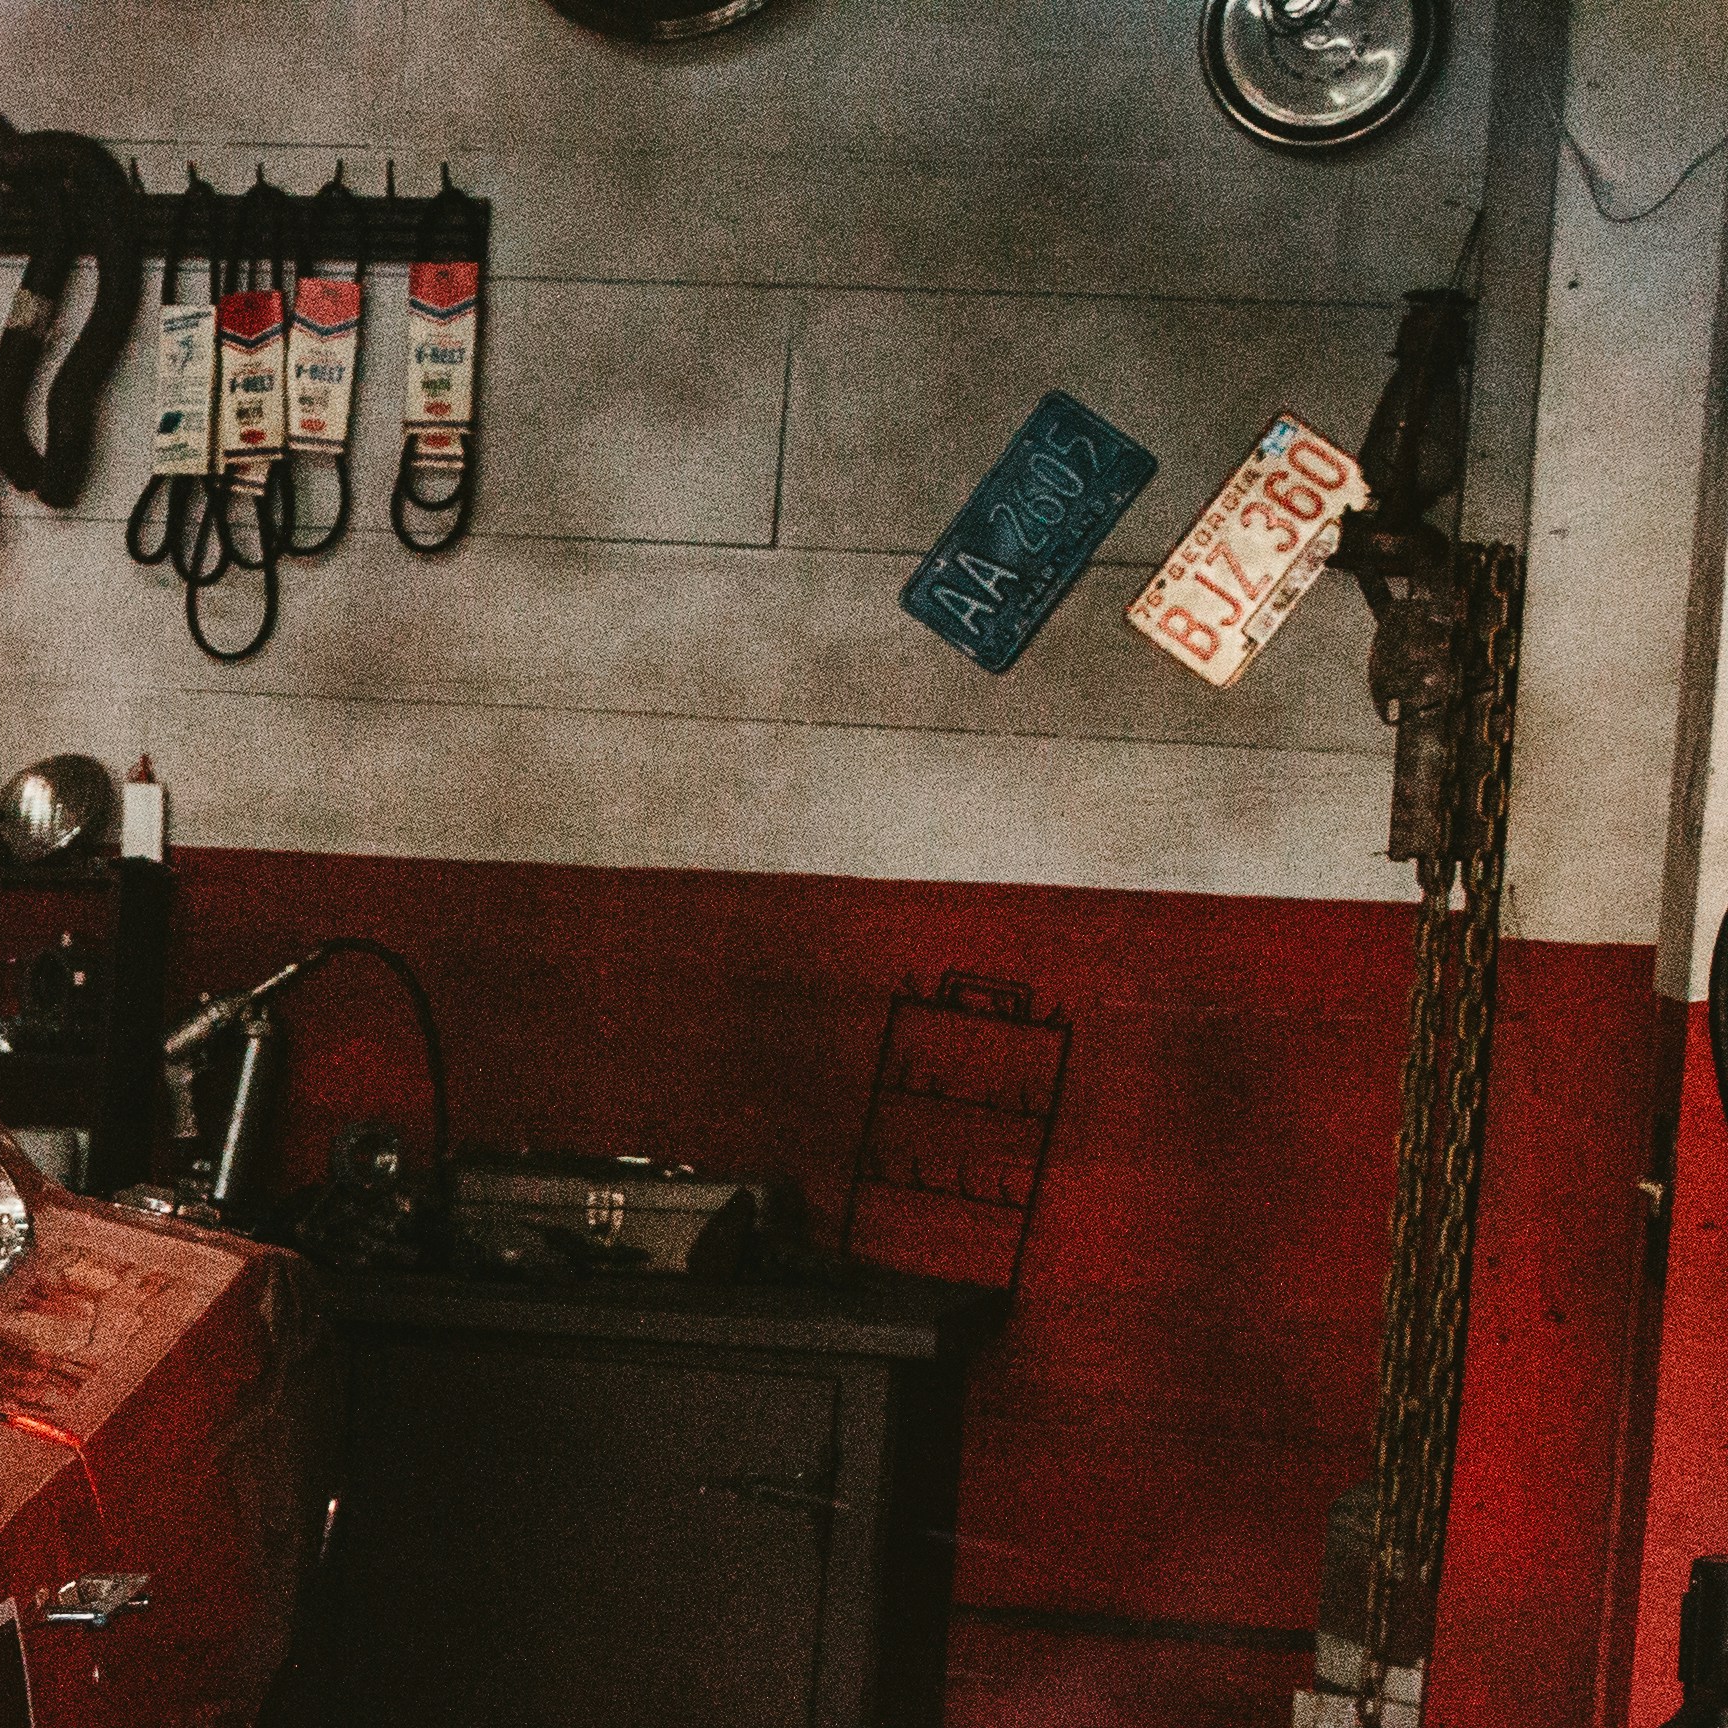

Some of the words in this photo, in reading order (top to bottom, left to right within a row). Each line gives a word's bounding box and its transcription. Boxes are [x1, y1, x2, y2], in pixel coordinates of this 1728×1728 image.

[1158, 540, 1271, 662] BJZ
[1241, 439, 1347, 553] 360
[1167, 470, 1263, 582] GEORGIA
